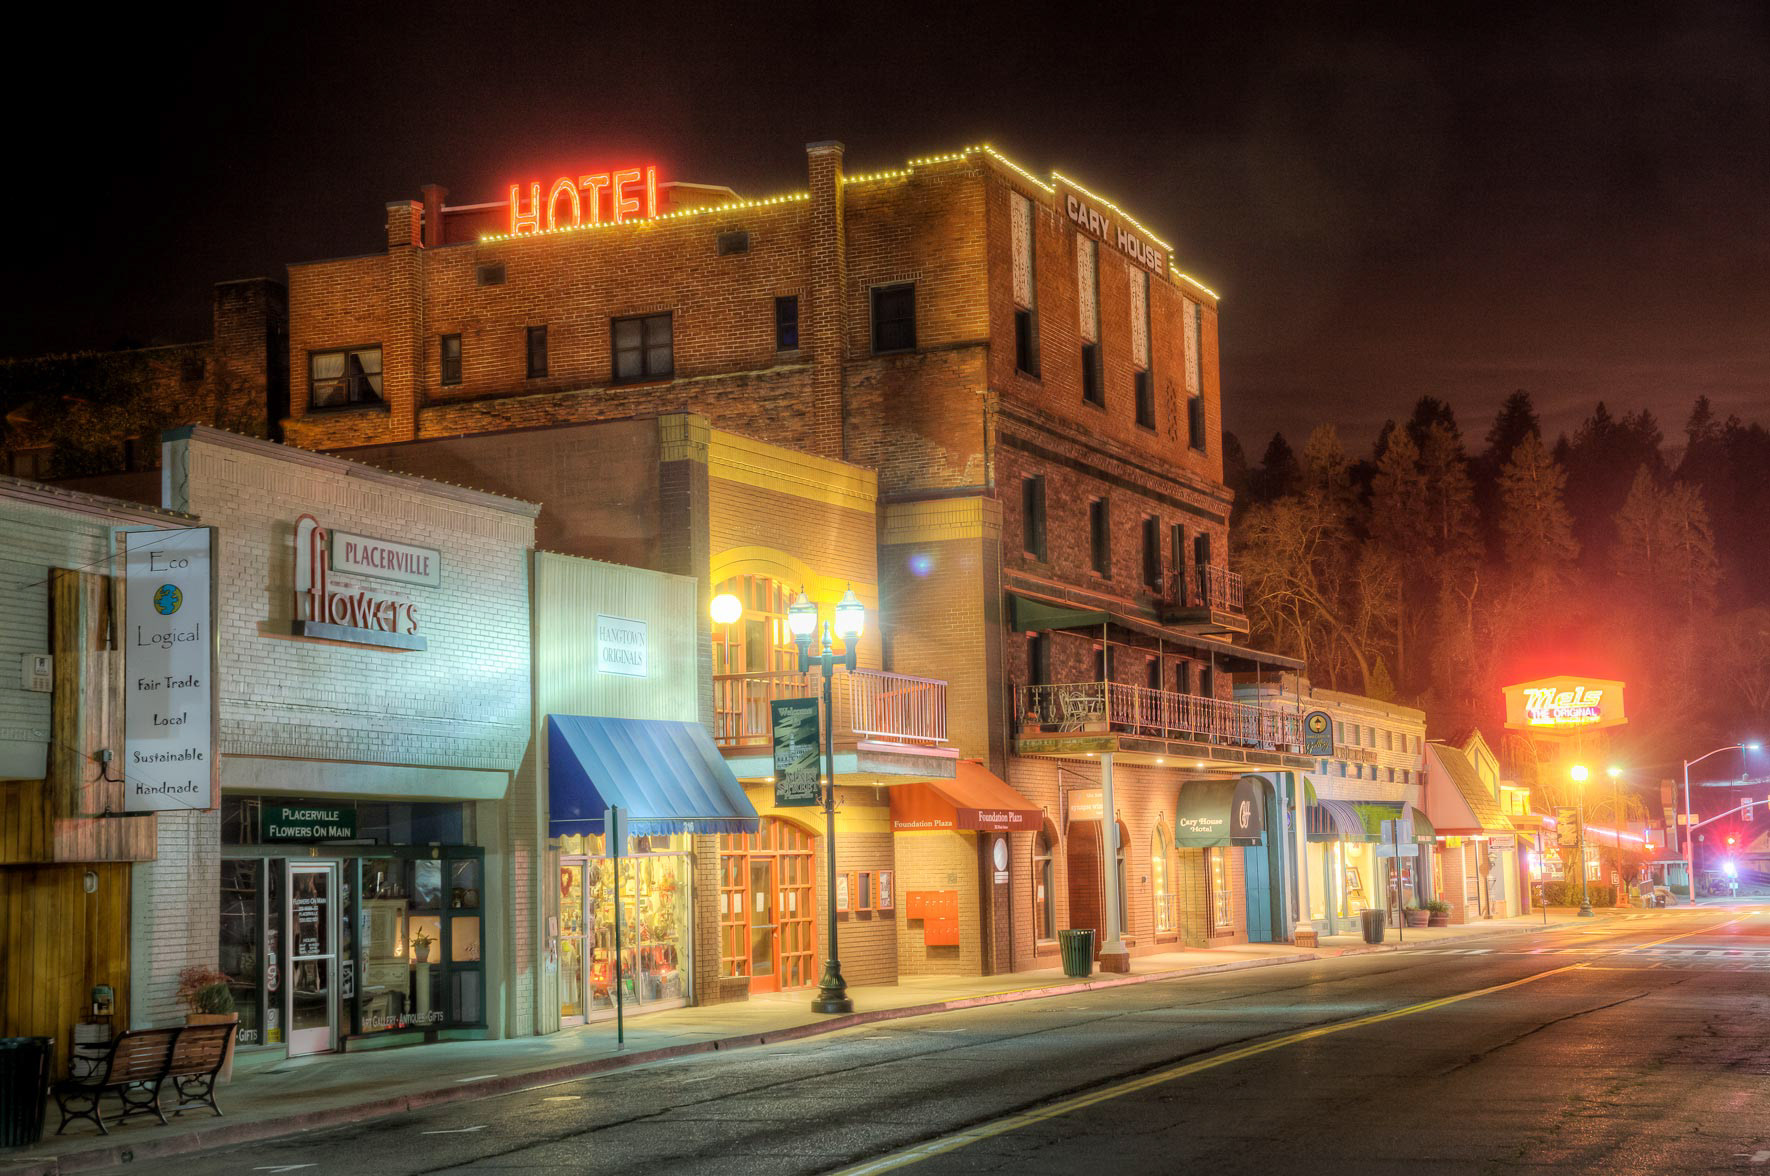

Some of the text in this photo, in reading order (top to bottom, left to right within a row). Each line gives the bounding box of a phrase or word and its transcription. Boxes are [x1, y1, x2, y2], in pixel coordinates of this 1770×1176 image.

[510, 166, 656, 234] HOTEL
[1067, 195, 1163, 275] CARY HOUSE
[150, 551, 188, 572] Eco
[345, 541, 430, 577] PLACERVILLE
[137, 622, 199, 649] Logical
[600, 626, 645, 646] HANGTOWN
[603, 647, 643, 666] ORIGINALS
[138, 675, 200, 691] Fair Trade
[153, 711, 187, 726] Local
[1554, 707, 1597, 717] ORIGINAL
[133, 747, 203, 763] Sustainable
[136, 780, 199, 795] Handmade
[282, 808, 340, 821] PLACERVILLE
[978, 811, 1023, 823] Foundation Plaza
[894, 819, 953, 828] Foundation Plaza
[1180, 817, 1223, 829] Cary House
[269, 825, 351, 838] FLOWERS ON MAIN
[239, 1028, 257, 1042] GIFTS
